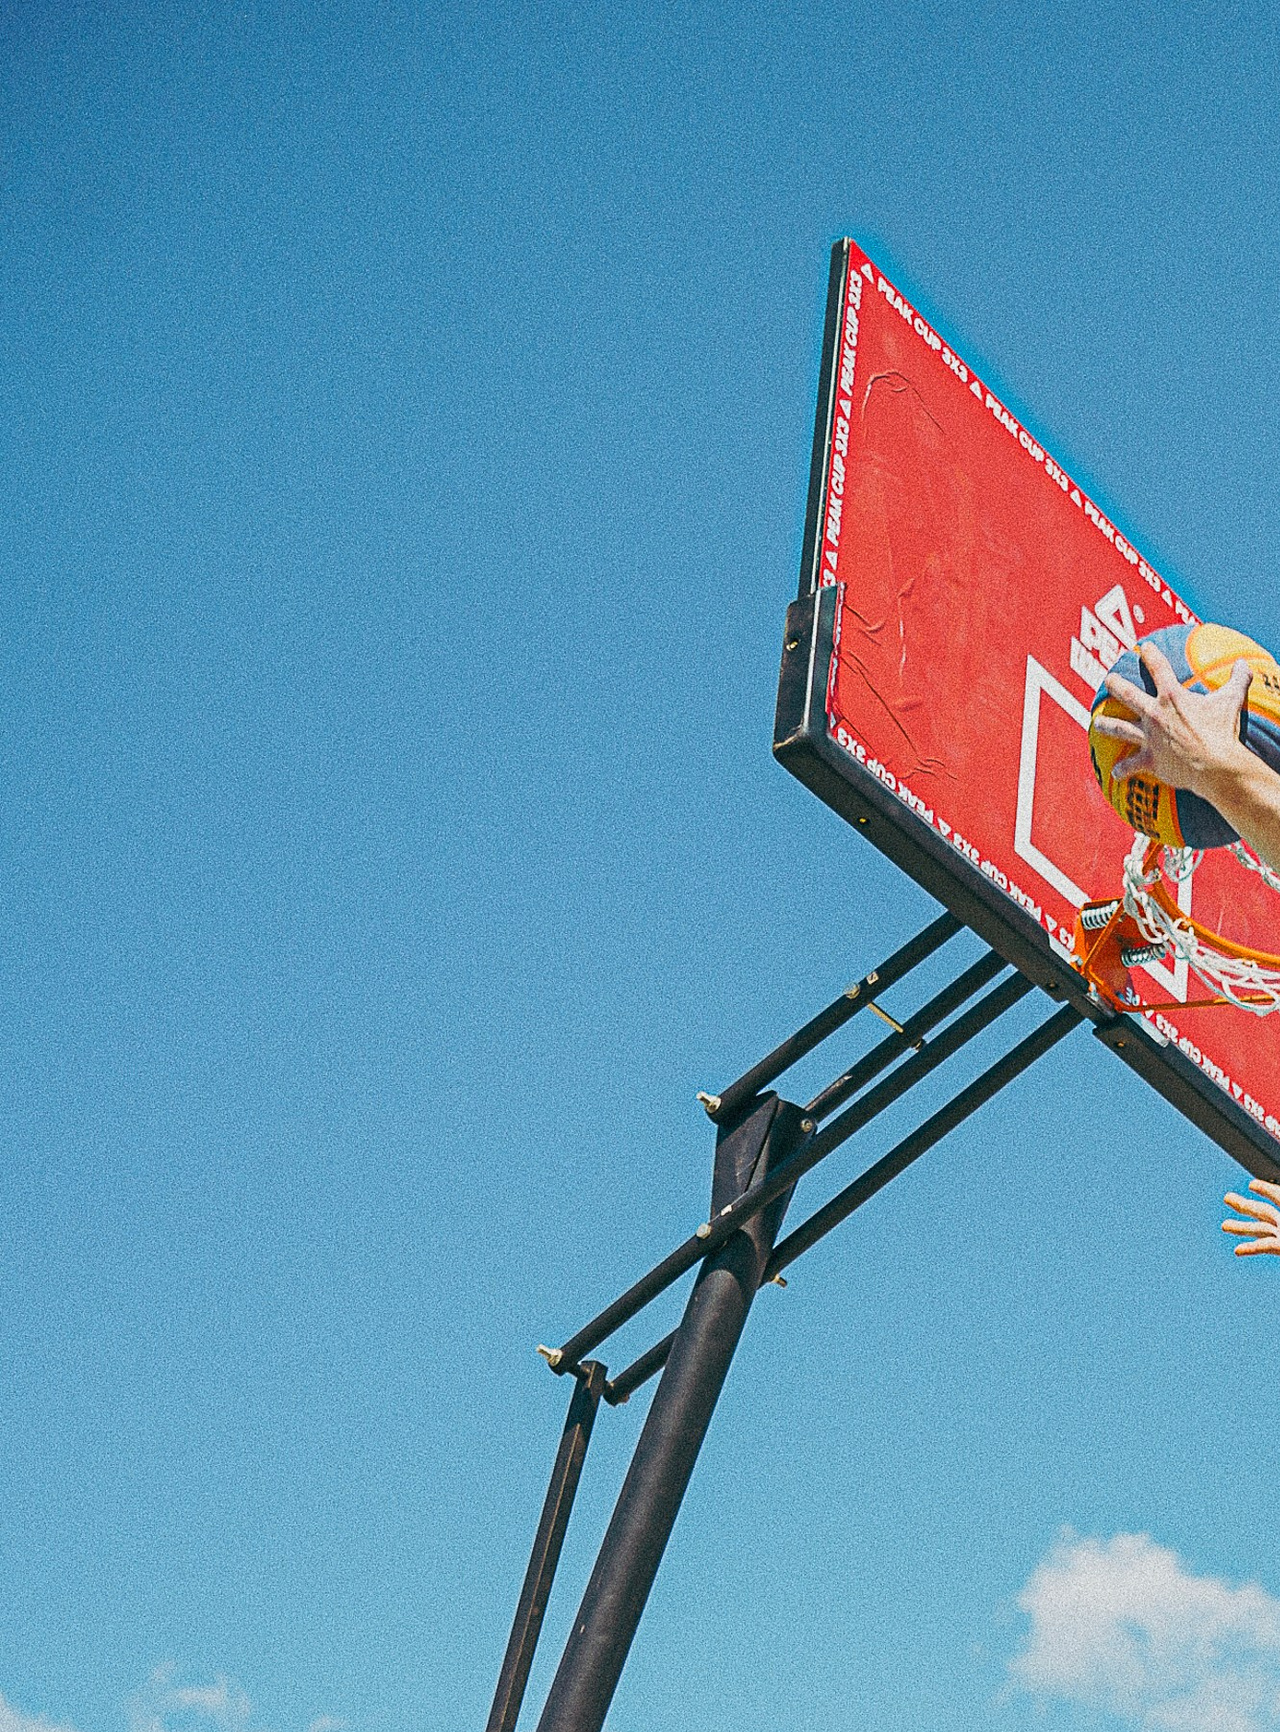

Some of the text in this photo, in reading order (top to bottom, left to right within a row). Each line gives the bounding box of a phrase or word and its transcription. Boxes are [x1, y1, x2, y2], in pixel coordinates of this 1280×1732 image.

[845, 306, 859, 347] CUP
[878, 277, 914, 325] PEAK
[914, 317, 942, 350] CUP
[841, 342, 857, 396] PEAK
[986, 393, 1019, 439] PEAK
[1019, 431, 1044, 462] CUP
[831, 453, 846, 495] CUP
[826, 492, 843, 547] PEAK
[1084, 501, 1115, 543] PEAK
[1115, 535, 1139, 565] CUP
[1175, 600, 1197, 625] PE
[866, 757, 897, 791] CUP
[898, 781, 934, 824] PEAK
[980, 859, 1008, 890] CUP
